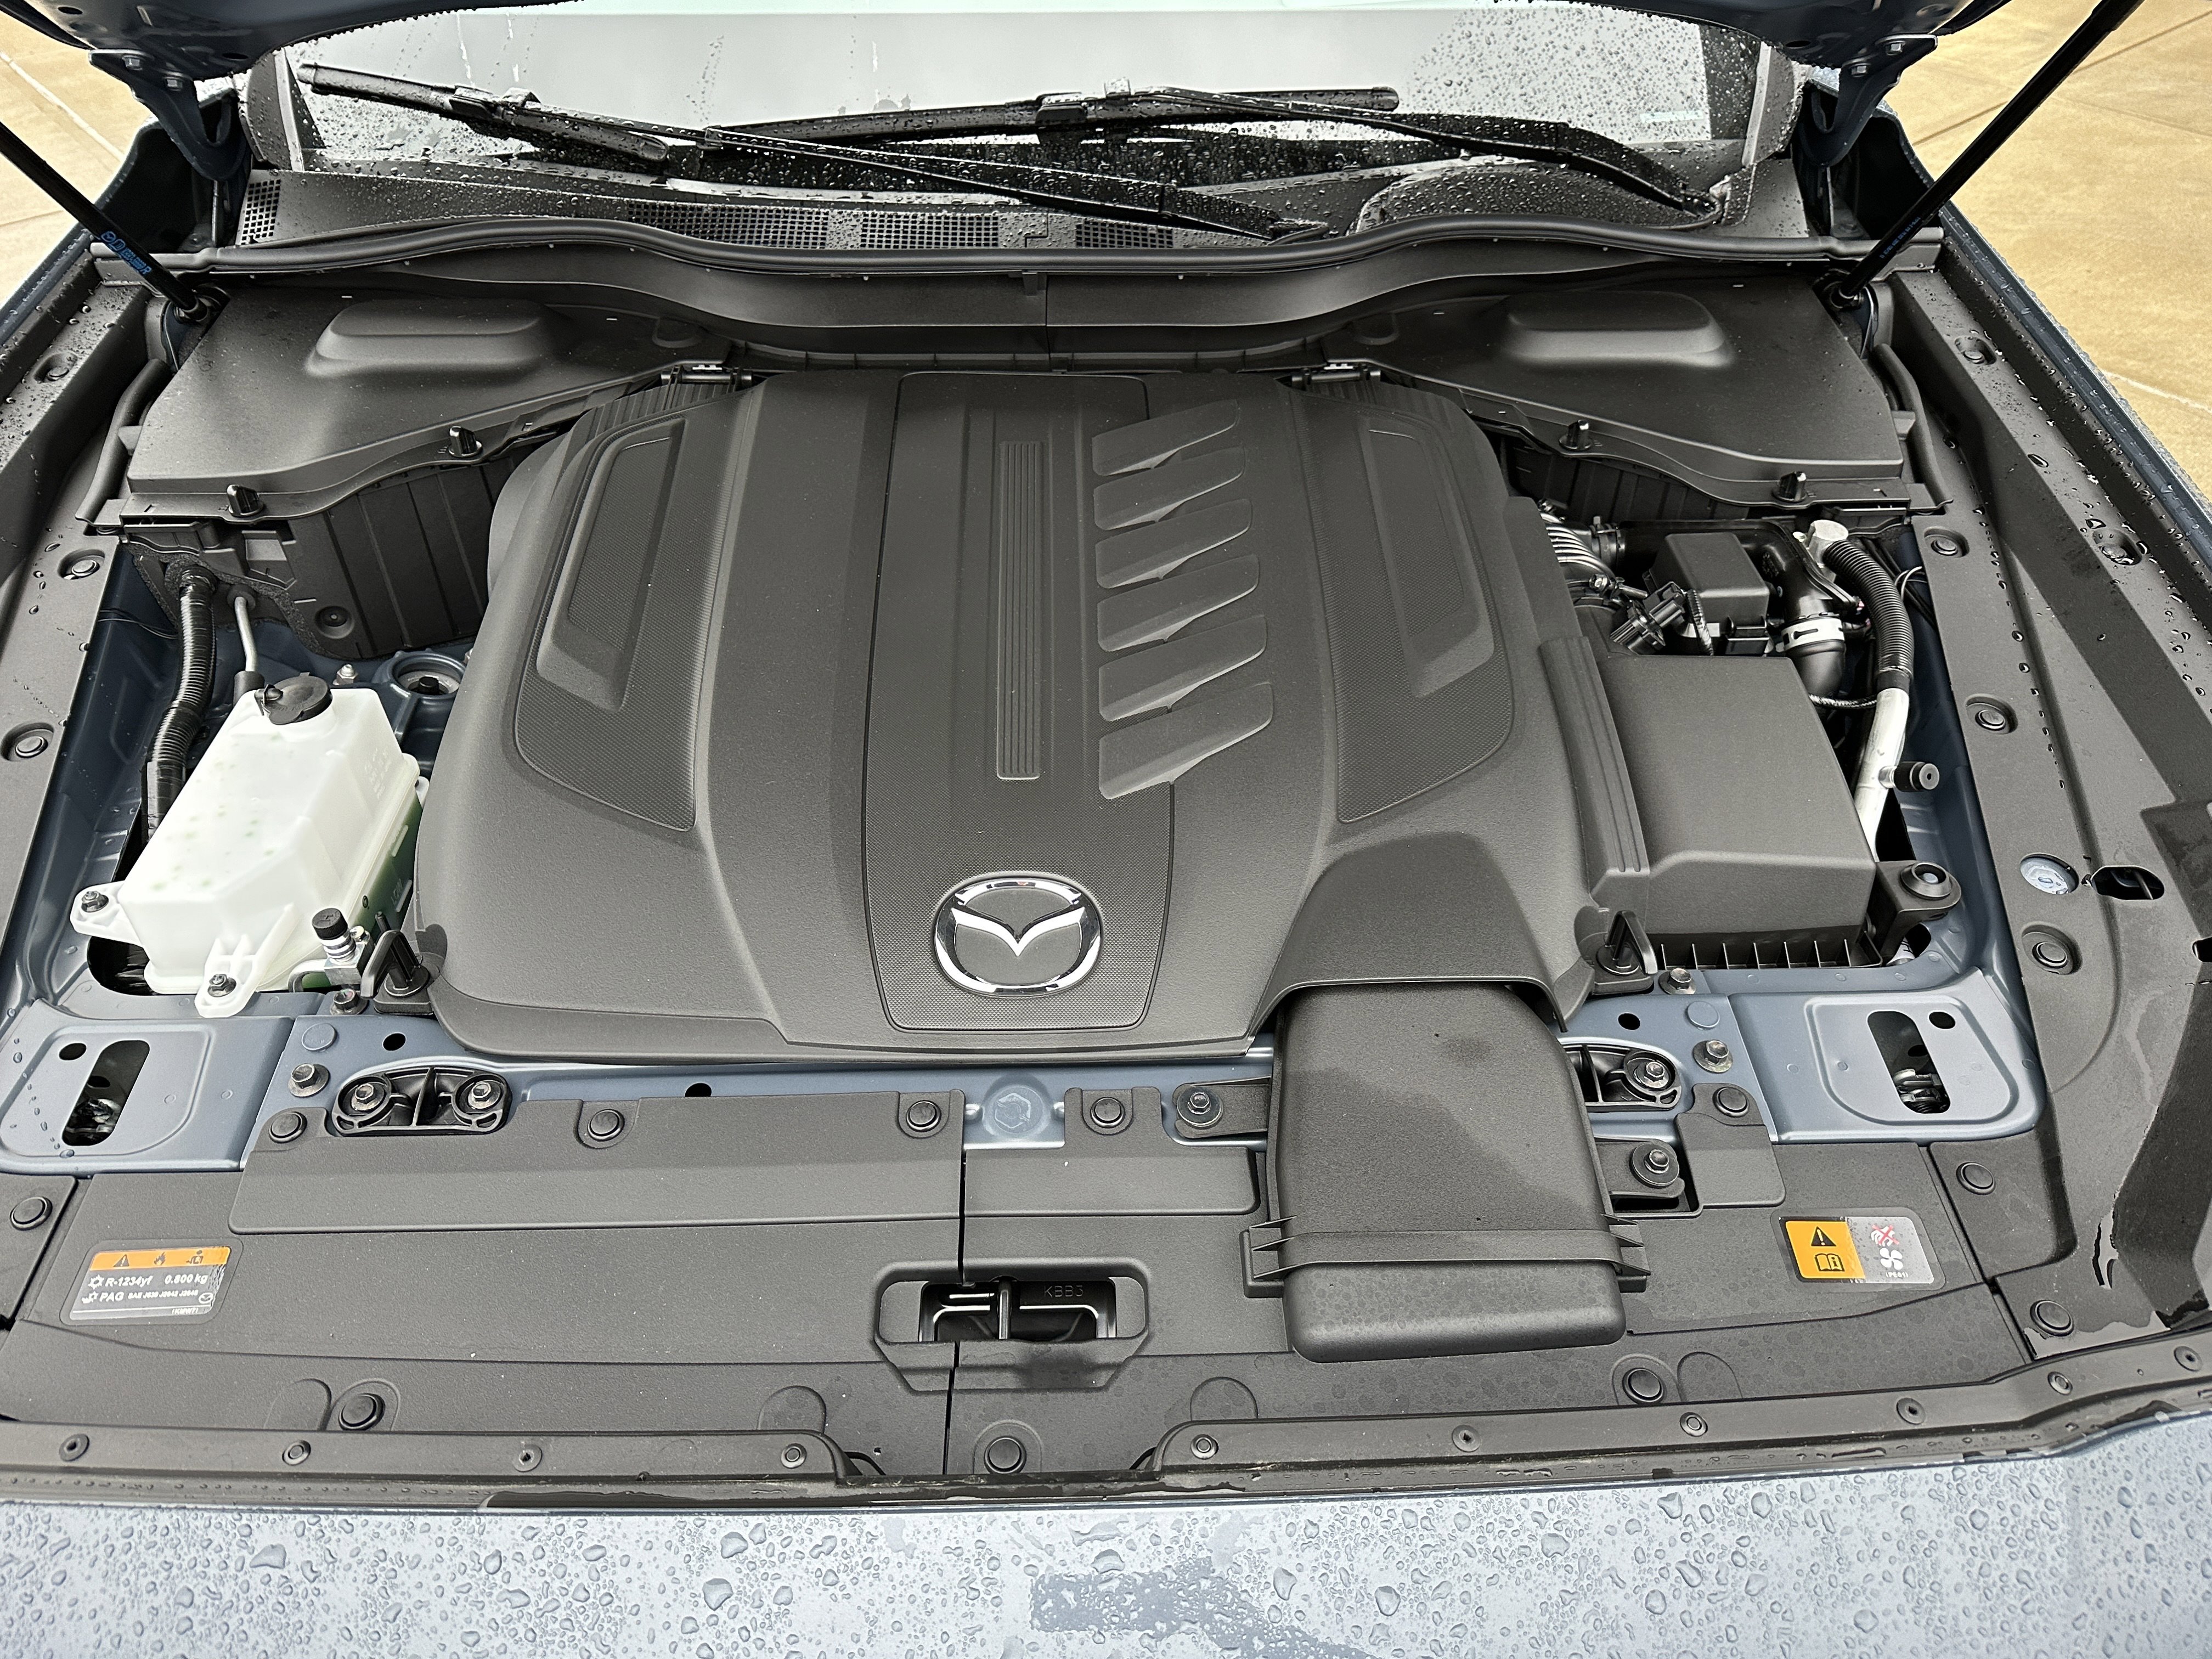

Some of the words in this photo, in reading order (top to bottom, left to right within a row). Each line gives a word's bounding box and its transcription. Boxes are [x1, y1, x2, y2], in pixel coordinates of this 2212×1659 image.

[105, 1274, 154, 1288] R-1234yf
[164, 1273, 194, 1284] 0.800
[194, 1273, 208, 1284] kg
[99, 1291, 125, 1302] PAG
[1044, 1285, 1084, 1297] KBB3
